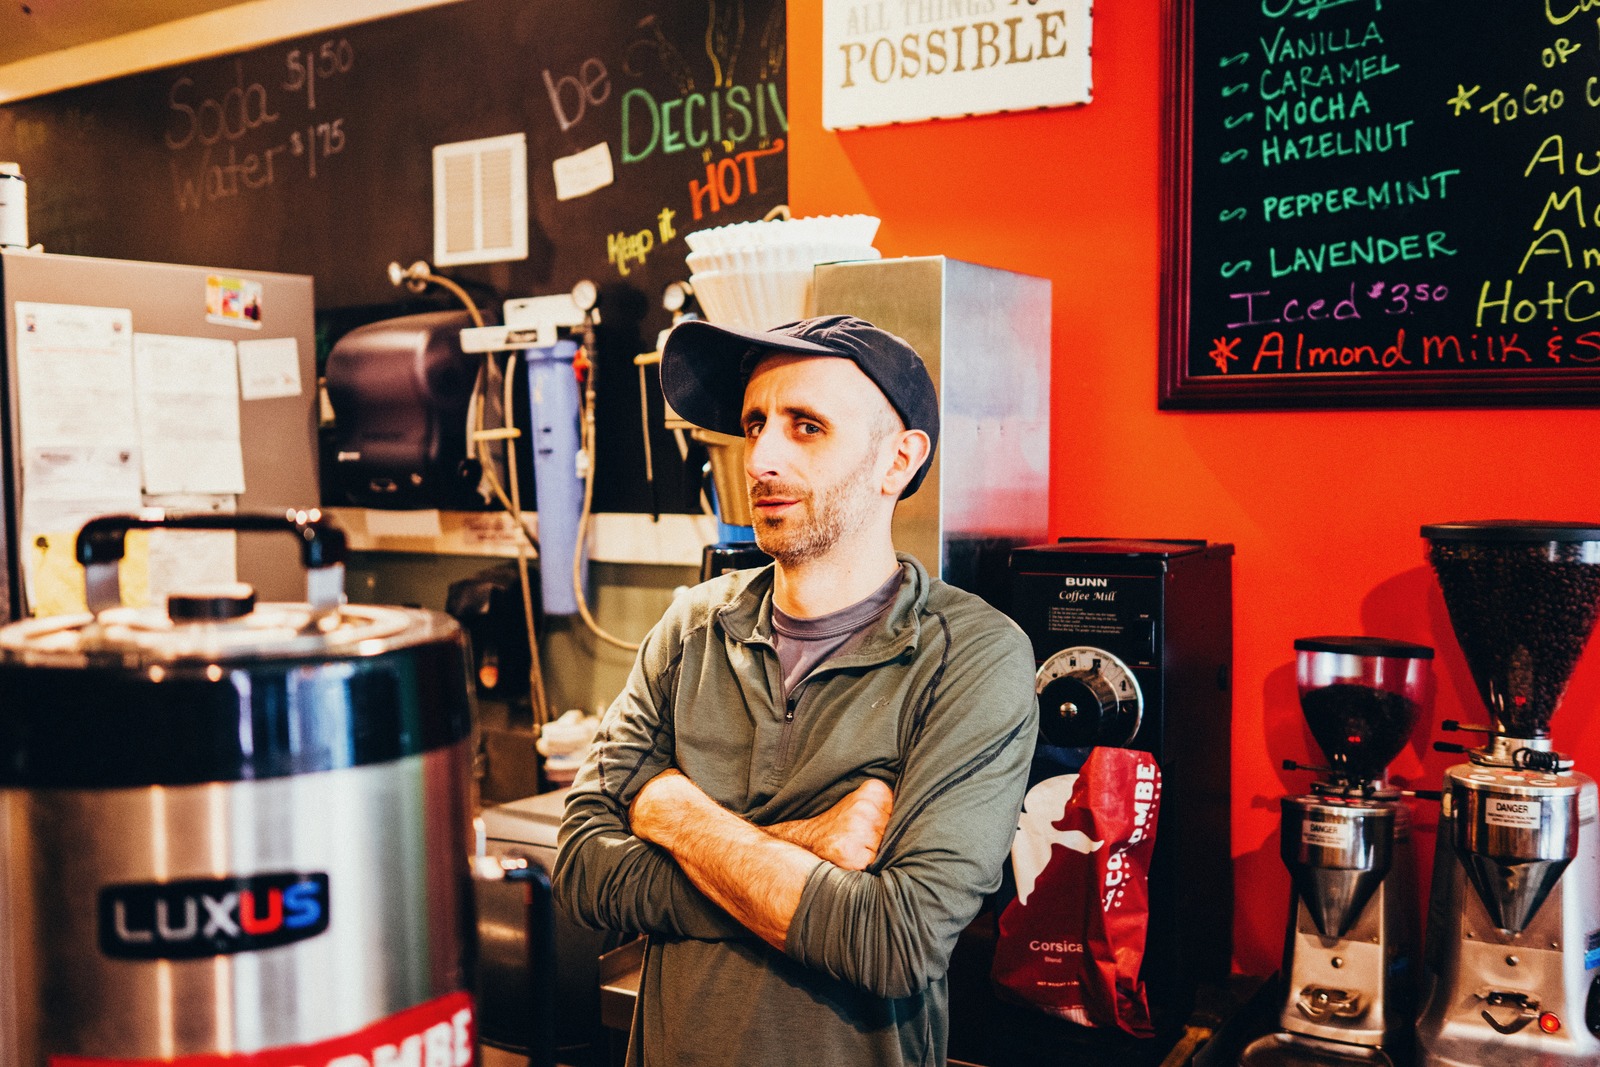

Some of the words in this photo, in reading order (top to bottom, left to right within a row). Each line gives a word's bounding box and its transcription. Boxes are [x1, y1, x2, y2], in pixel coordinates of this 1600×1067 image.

[839, 10, 1067, 88] POSSIBLE
[1260, 21, 1384, 64] VANILLA
[542, 57, 611, 131] be
[1259, 54, 1400, 100] CARAMEL
[165, 58, 280, 149] Soda
[1265, 91, 1371, 131] MOCHA
[1262, 120, 1414, 167] HAZELNUT
[689, 138, 785, 221] HOT
[1263, 168, 1461, 222] PEPPERMINT
[1269, 231, 1458, 278] LAVENDER
[1227, 281, 1361, 329] Iced
[1251, 328, 1412, 373] Almond
[1058, 590, 1090, 603] Coffee
[1092, 590, 1118, 602] Mill
[1065, 577, 1108, 588] BUNN
[1310, 823, 1338, 834] DANGER
[1495, 802, 1529, 814] DANGER
[113, 880, 321, 942] LUXUS
[1029, 940, 1084, 953] Corsica
